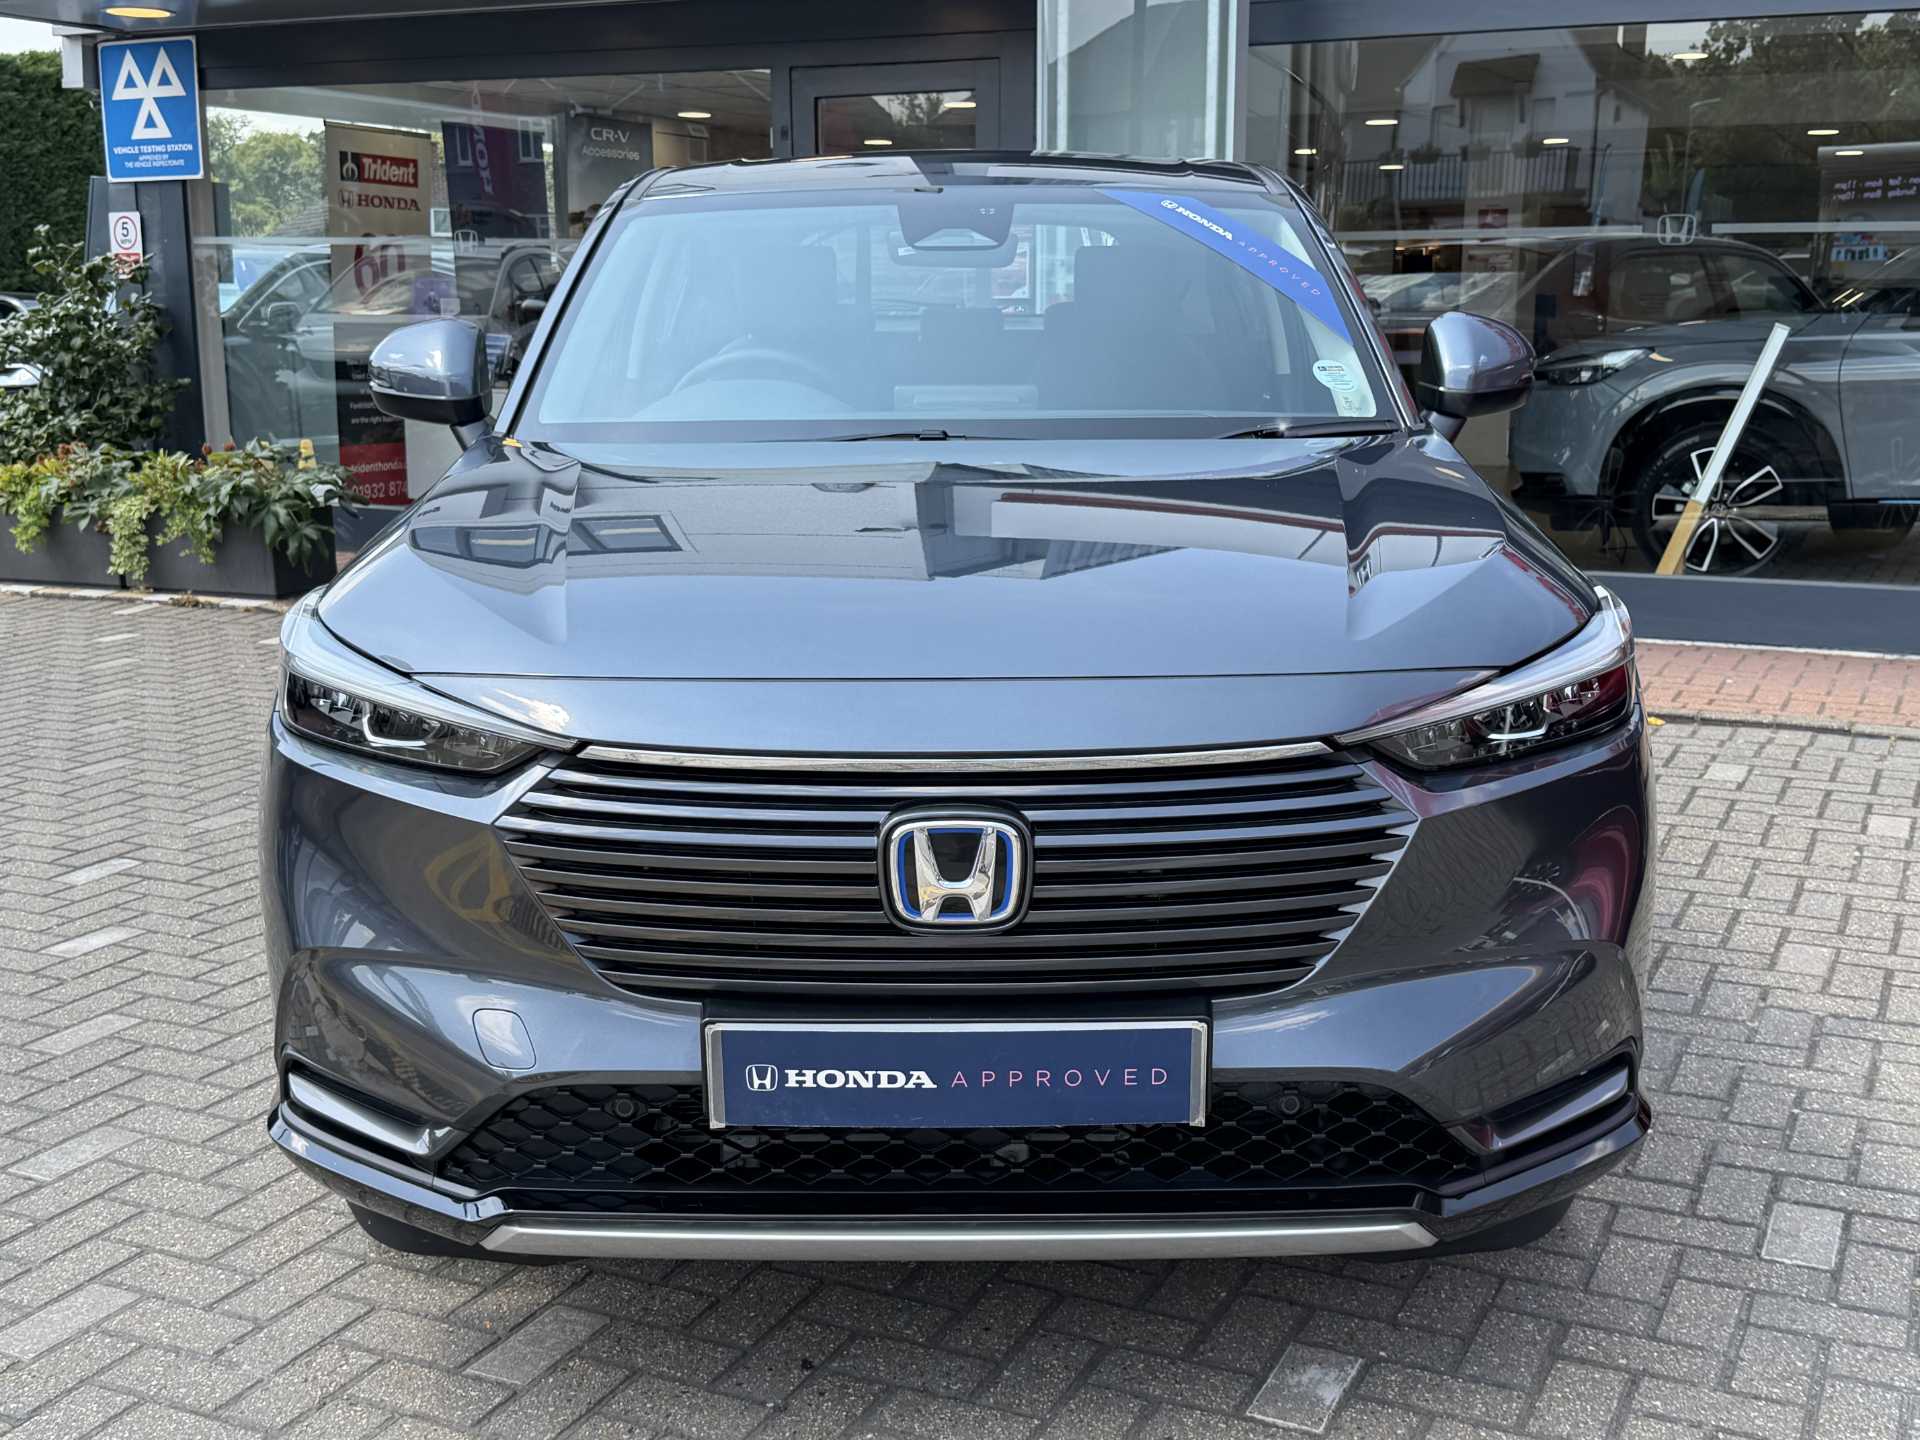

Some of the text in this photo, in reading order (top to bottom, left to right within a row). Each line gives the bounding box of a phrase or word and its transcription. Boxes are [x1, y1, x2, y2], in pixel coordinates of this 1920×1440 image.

[112, 143, 193, 154] VEHICLE TESTING STATION
[582, 145, 640, 160] Accessories
[361, 157, 416, 184] Trident
[357, 193, 421, 212] HONDA
[121, 221, 130, 238] 5
[1175, 206, 1321, 295] HONDA APPROVED
[784, 1068, 1168, 1089] HONDA APPROVED
